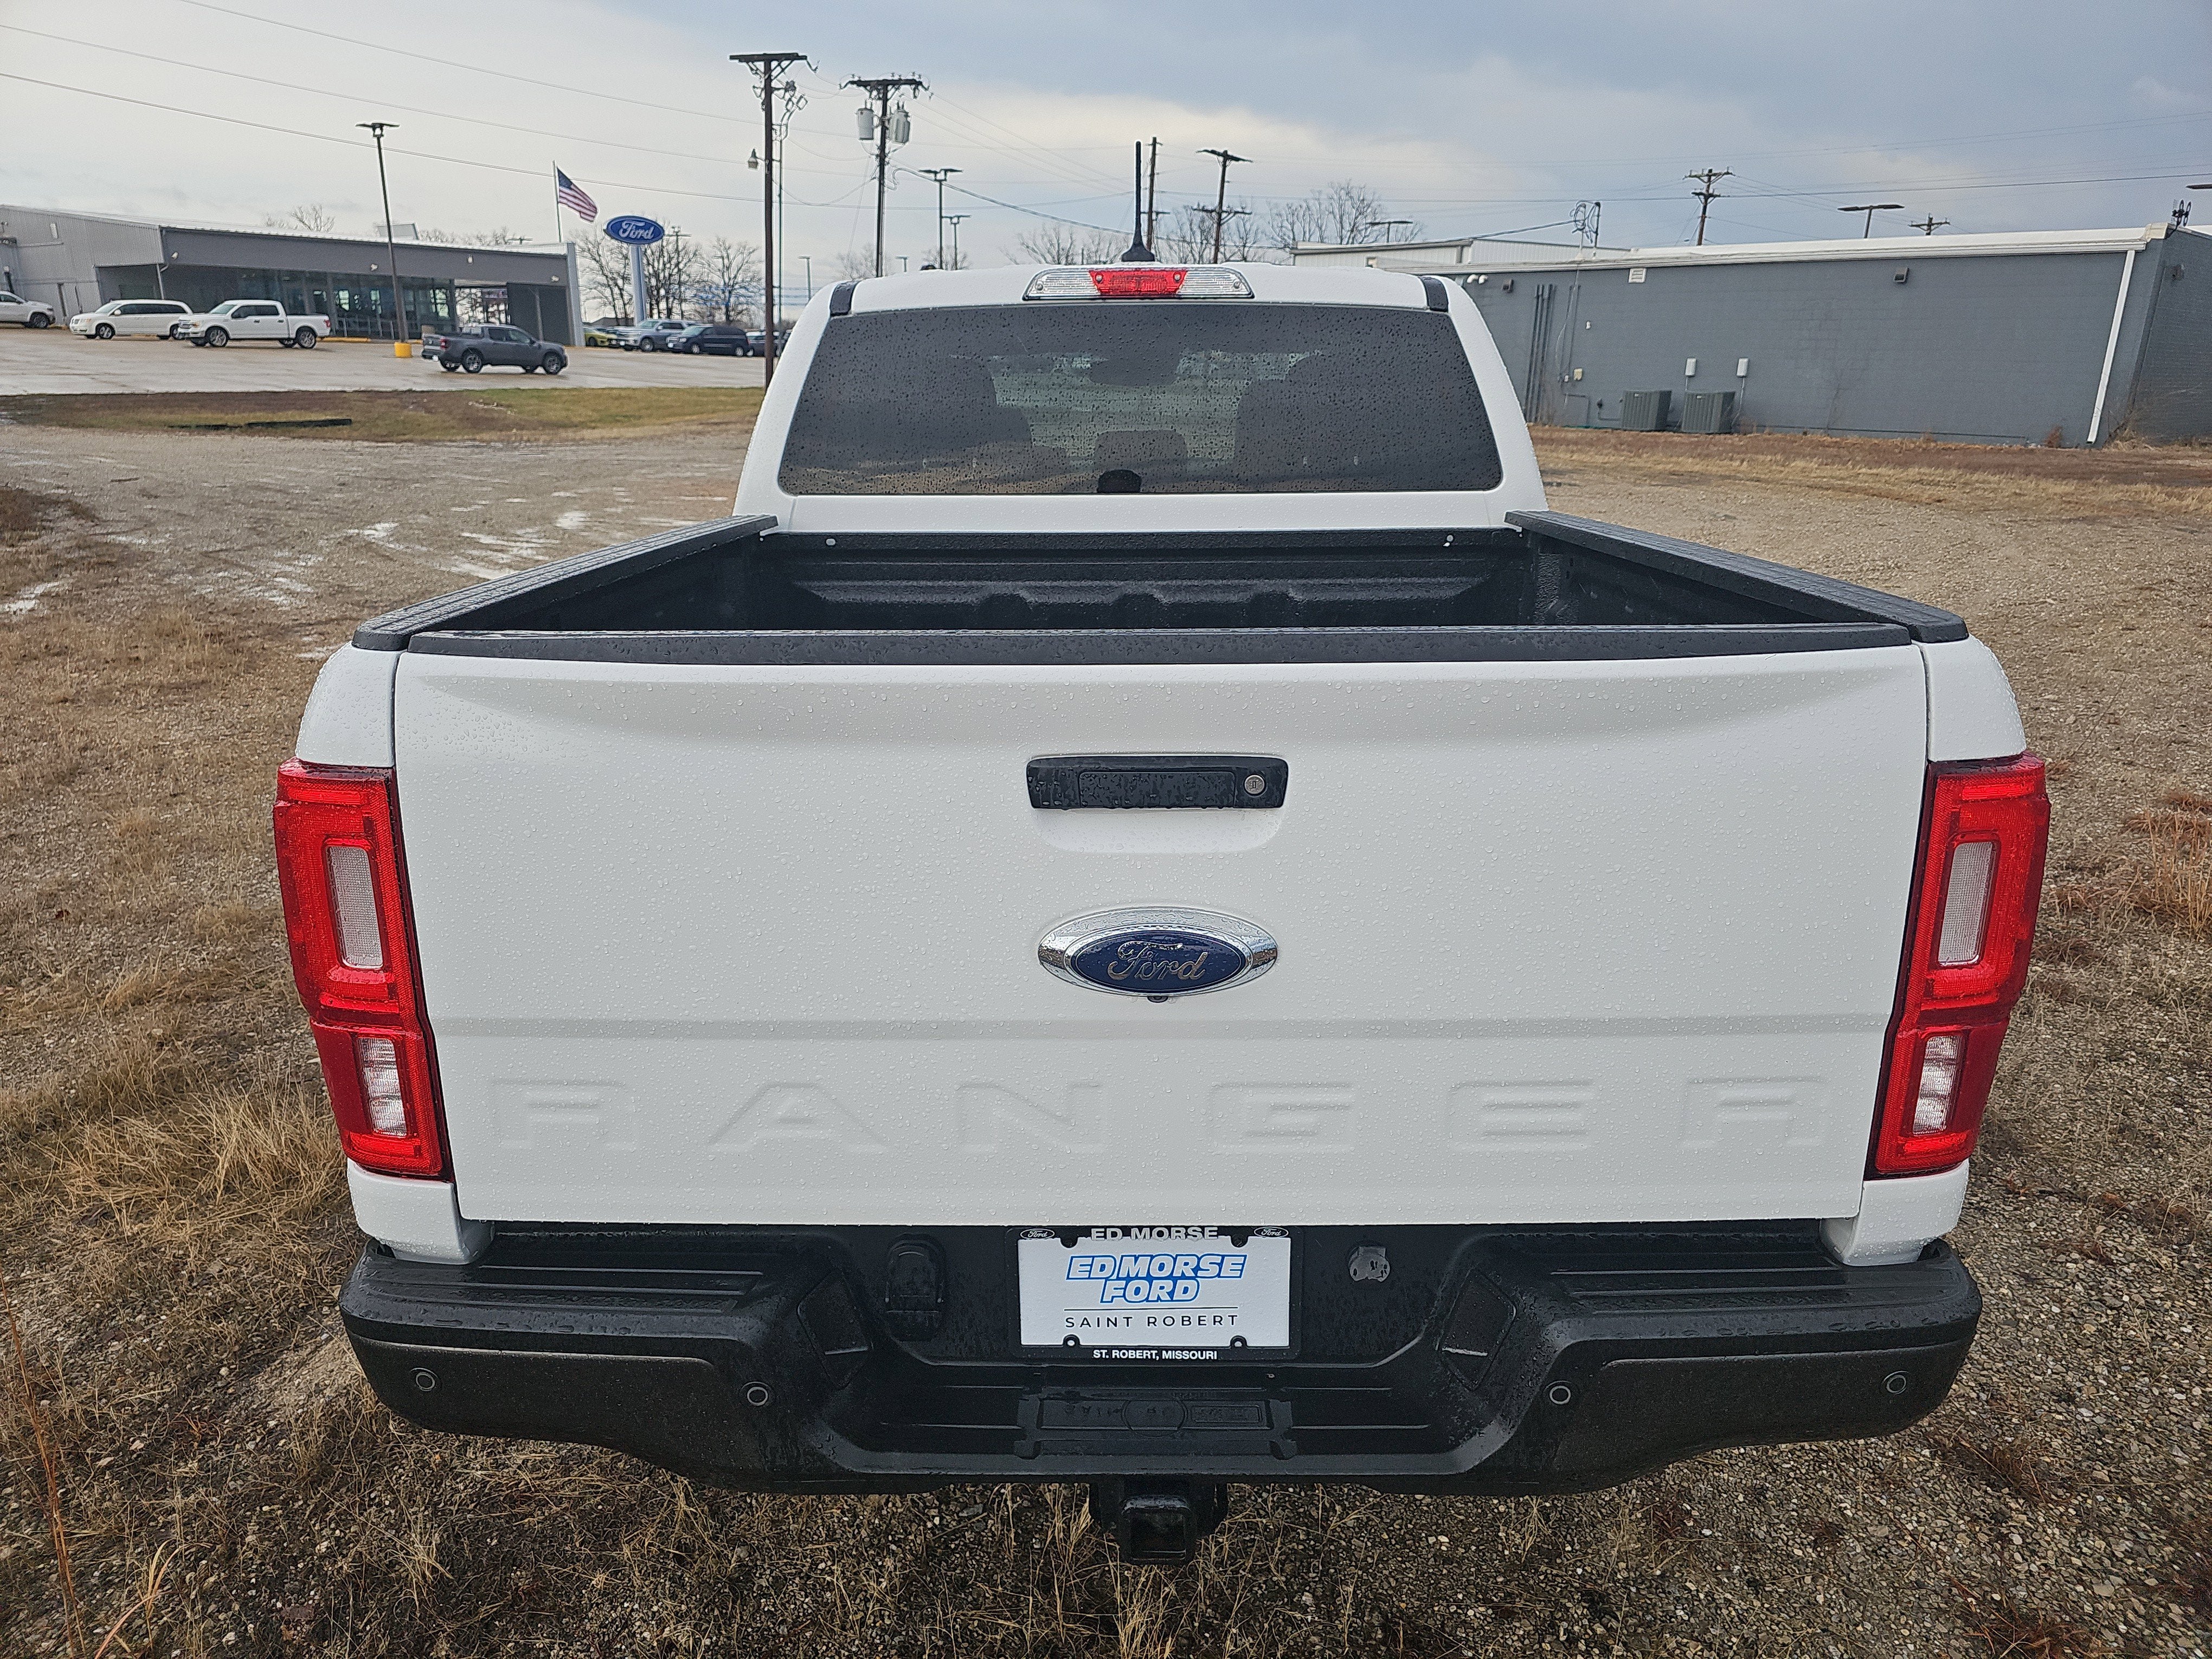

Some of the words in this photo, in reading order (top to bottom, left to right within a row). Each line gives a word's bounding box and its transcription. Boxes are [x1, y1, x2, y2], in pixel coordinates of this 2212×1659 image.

[619, 220, 654, 240] Ford
[1107, 940, 1209, 981] Ford
[490, 1076, 1828, 1154] RANGER
[1027, 1230, 1048, 1238] Ford
[1091, 1227, 1123, 1241] ED
[1131, 1226, 1218, 1240] MORSE
[1261, 1228, 1281, 1236] Ford
[1100, 1278, 1200, 1303] FORD
[1065, 1316, 1133, 1328] SAINT
[1147, 1315, 1238, 1327] ROBERT
[1093, 1350, 1111, 1359] ST.
[1112, 1350, 1159, 1360] ROBERT,
[1162, 1351, 1218, 1360] MISSOURI
